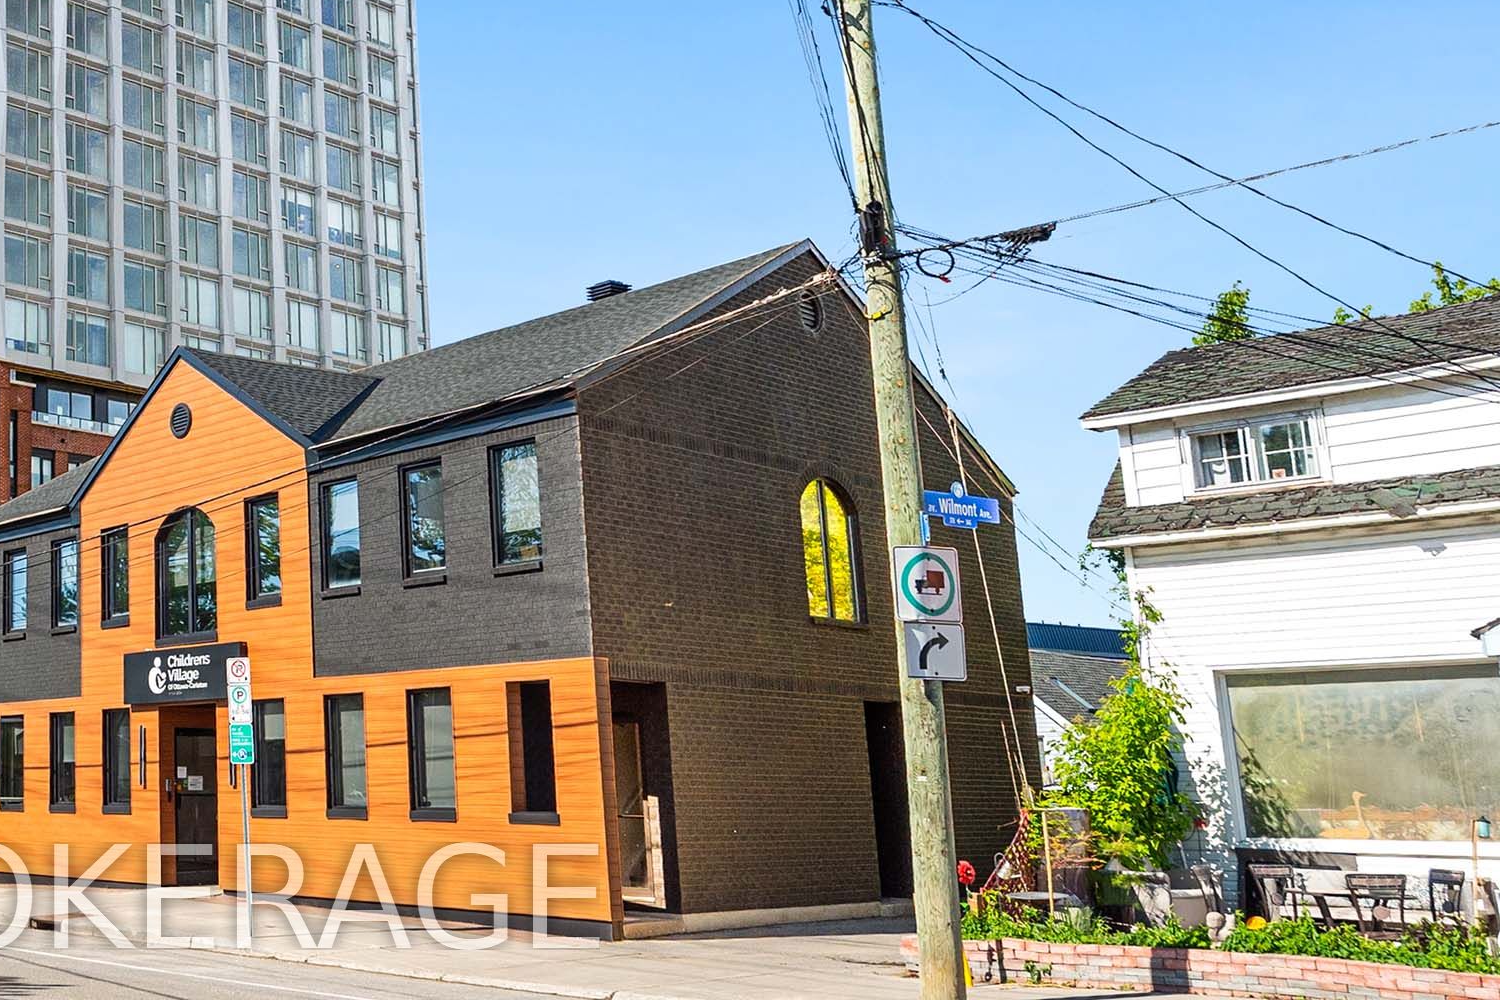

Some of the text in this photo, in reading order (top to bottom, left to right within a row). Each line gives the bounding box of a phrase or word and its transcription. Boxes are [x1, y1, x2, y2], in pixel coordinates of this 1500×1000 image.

[938, 497, 978, 517] Wilmont
[979, 508, 993, 519] Ave.
[167, 653, 211, 668] Childrens
[167, 668, 200, 683] Village
